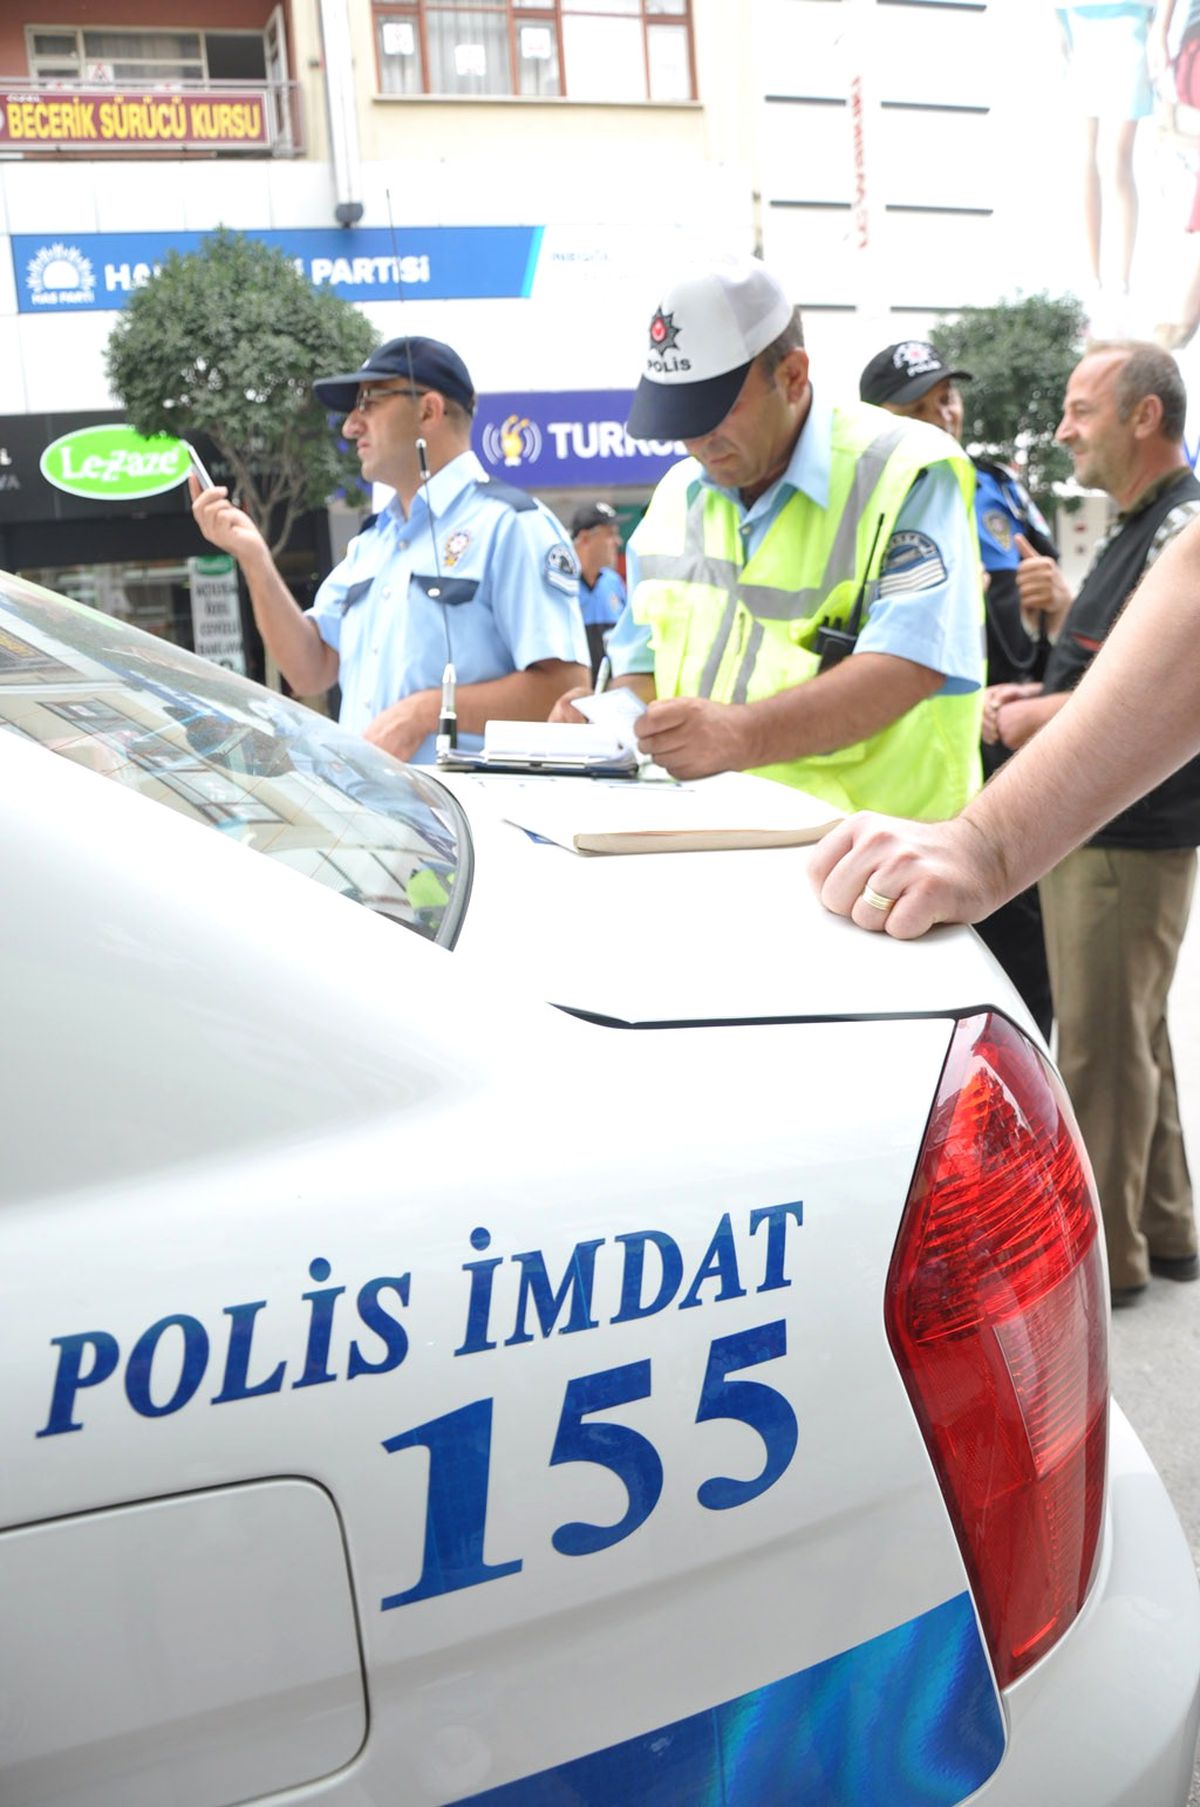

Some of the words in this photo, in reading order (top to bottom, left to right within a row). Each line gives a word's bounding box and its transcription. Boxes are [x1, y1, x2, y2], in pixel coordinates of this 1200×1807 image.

[6, 96, 97, 139] BECERİK
[100, 96, 187, 139] SÜRÜCÜ
[191, 101, 261, 138] KURSU
[311, 255, 430, 286] PARTİSİ
[647, 356, 691, 373] POLİS
[35, 1257, 412, 1439] POLİS
[453, 1200, 804, 1357] İMDAT
[380, 1318, 799, 1613] 155
